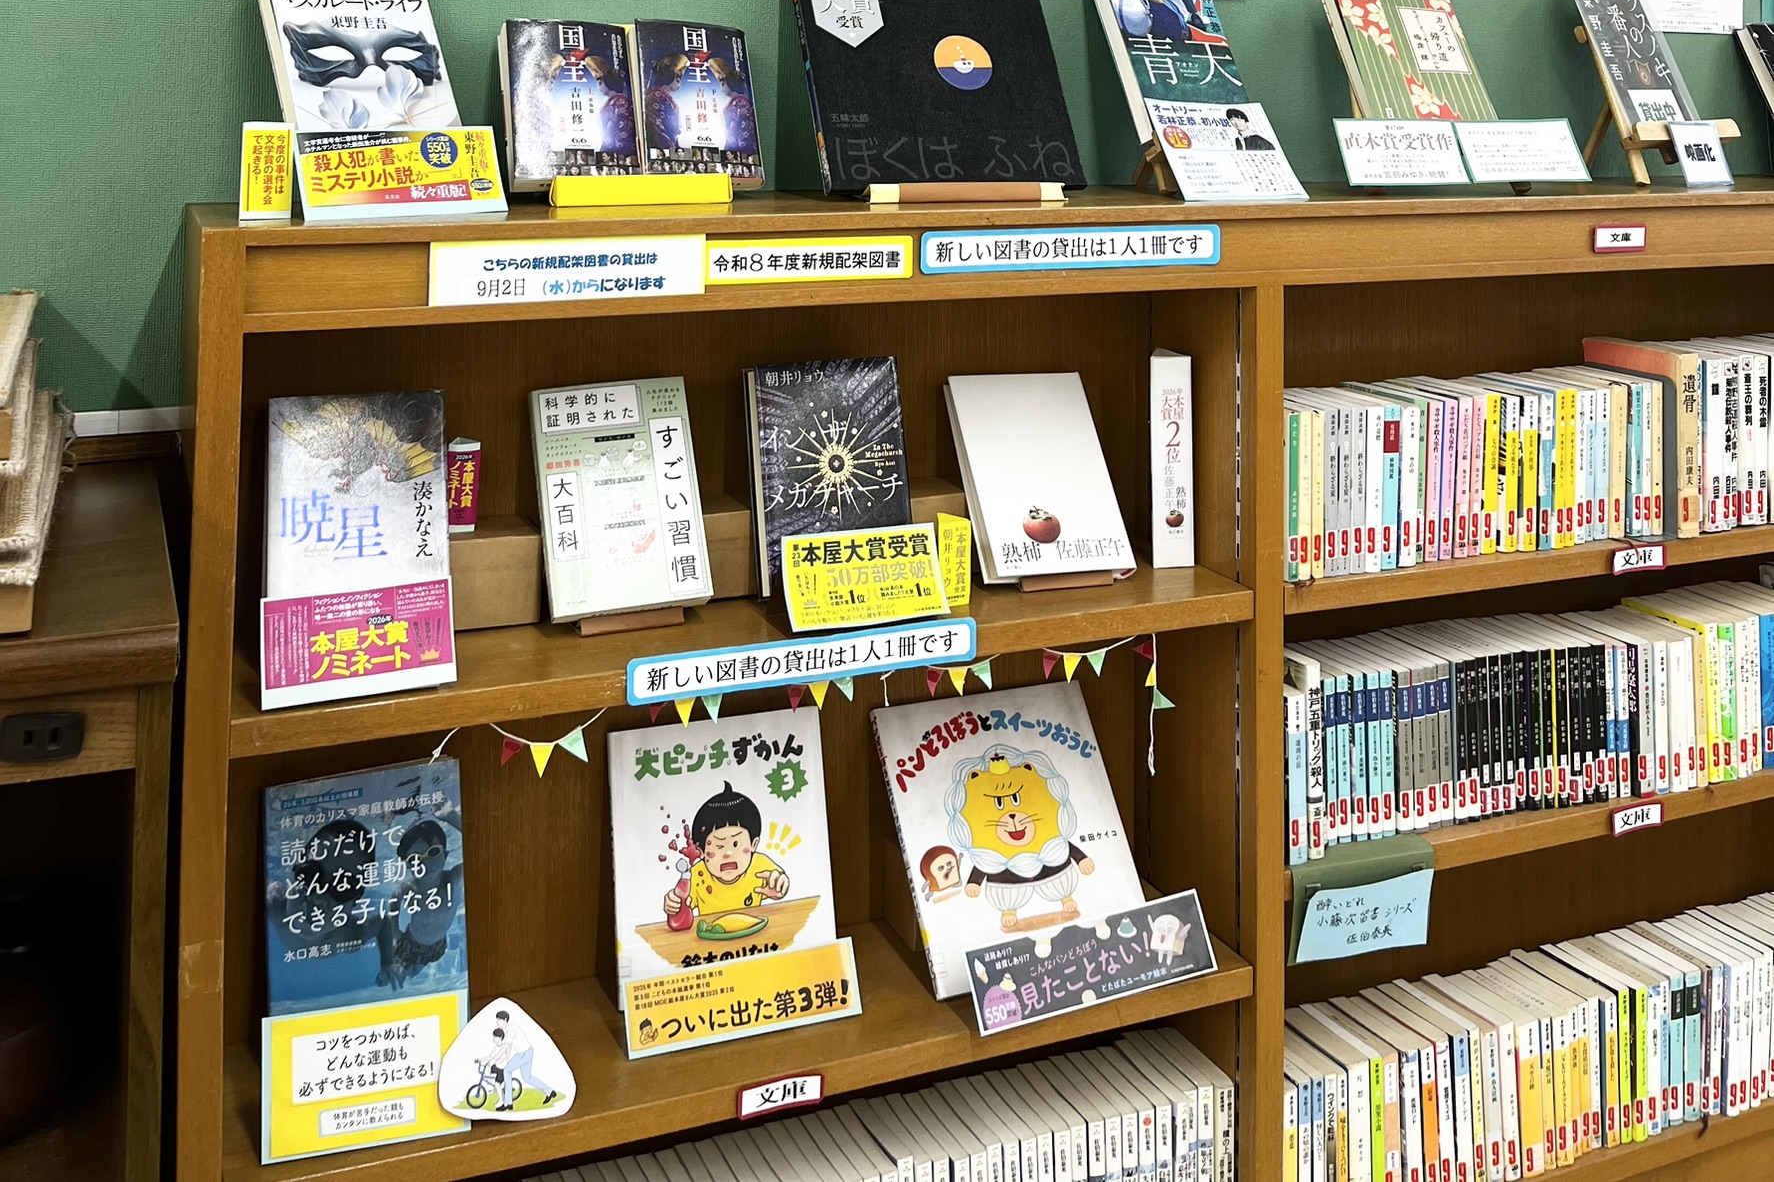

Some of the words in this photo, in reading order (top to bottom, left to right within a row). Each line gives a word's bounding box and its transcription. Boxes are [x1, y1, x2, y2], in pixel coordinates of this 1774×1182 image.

[330, 15, 388, 30] 東野圭吾
[836, 15, 864, 30] 受賞
[558, 24, 588, 83] 国宝
[682, 26, 711, 83] 国宝
[1128, 34, 1243, 87] 青天
[570, 87, 584, 133] 吉田修一
[1153, 104, 1202, 114] オードリー・
[1157, 116, 1231, 128] 若林正恭、初小説
[1638, 101, 1676, 122] 貸出中
[1344, 132, 1453, 151] 直木賞受賞作
[1684, 143, 1716, 163] 映画化
[251, 134, 264, 185] で起きる!
[263, 134, 274, 206] 文学賞の選考会
[275, 134, 286, 195] 今度の事件は
[835, 137, 964, 180] ぼくは
[984, 135, 1076, 179] ふね
[410, 184, 467, 200] 続々重版!
[936, 234, 1203, 263] 新しい図書の貸出は1人1冊です
[1610, 233, 1631, 243] 文庫
[483, 252, 658, 272] こちらの新規配架図書の貸出は
[713, 250, 901, 273] 令和8年度新規配架図書
[477, 278, 526, 298] 9月2日
[542, 275, 666, 295] (水)からになります
[765, 370, 824, 387] 朝井リョウ
[1682, 374, 1697, 413] 遺骨
[544, 392, 616, 410] 科学的に
[546, 407, 634, 428] 証明された
[1165, 421, 1181, 464] 2位
[1685, 446, 1694, 485] 内田康夫
[461, 461, 475, 507] 本屋大賞
[765, 473, 903, 513] メガチャーチ
[413, 481, 433, 558] 湊かなえ
[553, 478, 578, 553] 大百科
[656, 425, 699, 583] すごい習慣
[1683, 497, 1689, 521] 9
[280, 491, 388, 562] 暁星
[801, 533, 930, 567] 本屋大賞受賞
[942, 529, 954, 588] 朝井リョウ
[955, 531, 967, 585] 本屋大賞
[1001, 541, 1042, 564] 熟柿
[1055, 538, 1125, 560] 佐藤正午
[826, 559, 934, 588] 50万部突破!
[849, 589, 866, 605] 1位
[915, 582, 932, 597] 1位
[310, 621, 409, 655] 本屋大賞
[311, 645, 411, 680] ノミネート
[646, 630, 959, 692] 新しい図書の貸出は1人1冊です
[634, 734, 803, 781] 大ピンチずかん
[780, 770, 795, 792] 3
[896, 710, 1096, 793] パンどろぼうとスイーツおうじ
[281, 791, 444, 829] 体育のカリスマ家庭教師が伝授
[1620, 808, 1650, 829] 文庫
[281, 825, 405, 866] 読むだけで
[1080, 830, 1118, 843] 柴田ケイコ
[285, 854, 427, 900] どんな運動も
[283, 882, 453, 934] できる子になる!
[1316, 897, 1365, 912] 酔いどれ
[1385, 898, 1417, 918] シリーズ
[1346, 924, 1393, 944] 佐伯泰英
[283, 944, 332, 963] 水口高志
[1029, 939, 1098, 977] こんなパンどろぼう
[1021, 930, 1151, 1015] 見たことない!
[1101, 966, 1168, 992] どたばたユーモア絵本
[661, 979, 849, 1038] ついに出た第3弾!
[316, 1024, 415, 1053] コツをつかめば、
[326, 1046, 408, 1071] どんな運動も
[298, 1063, 435, 1099] 必ずできるようになる!
[755, 1080, 807, 1106] 文庫
[333, 1103, 404, 1121] 体育が苦手だった親も
[334, 1111, 404, 1131] カンタンに教えられる
